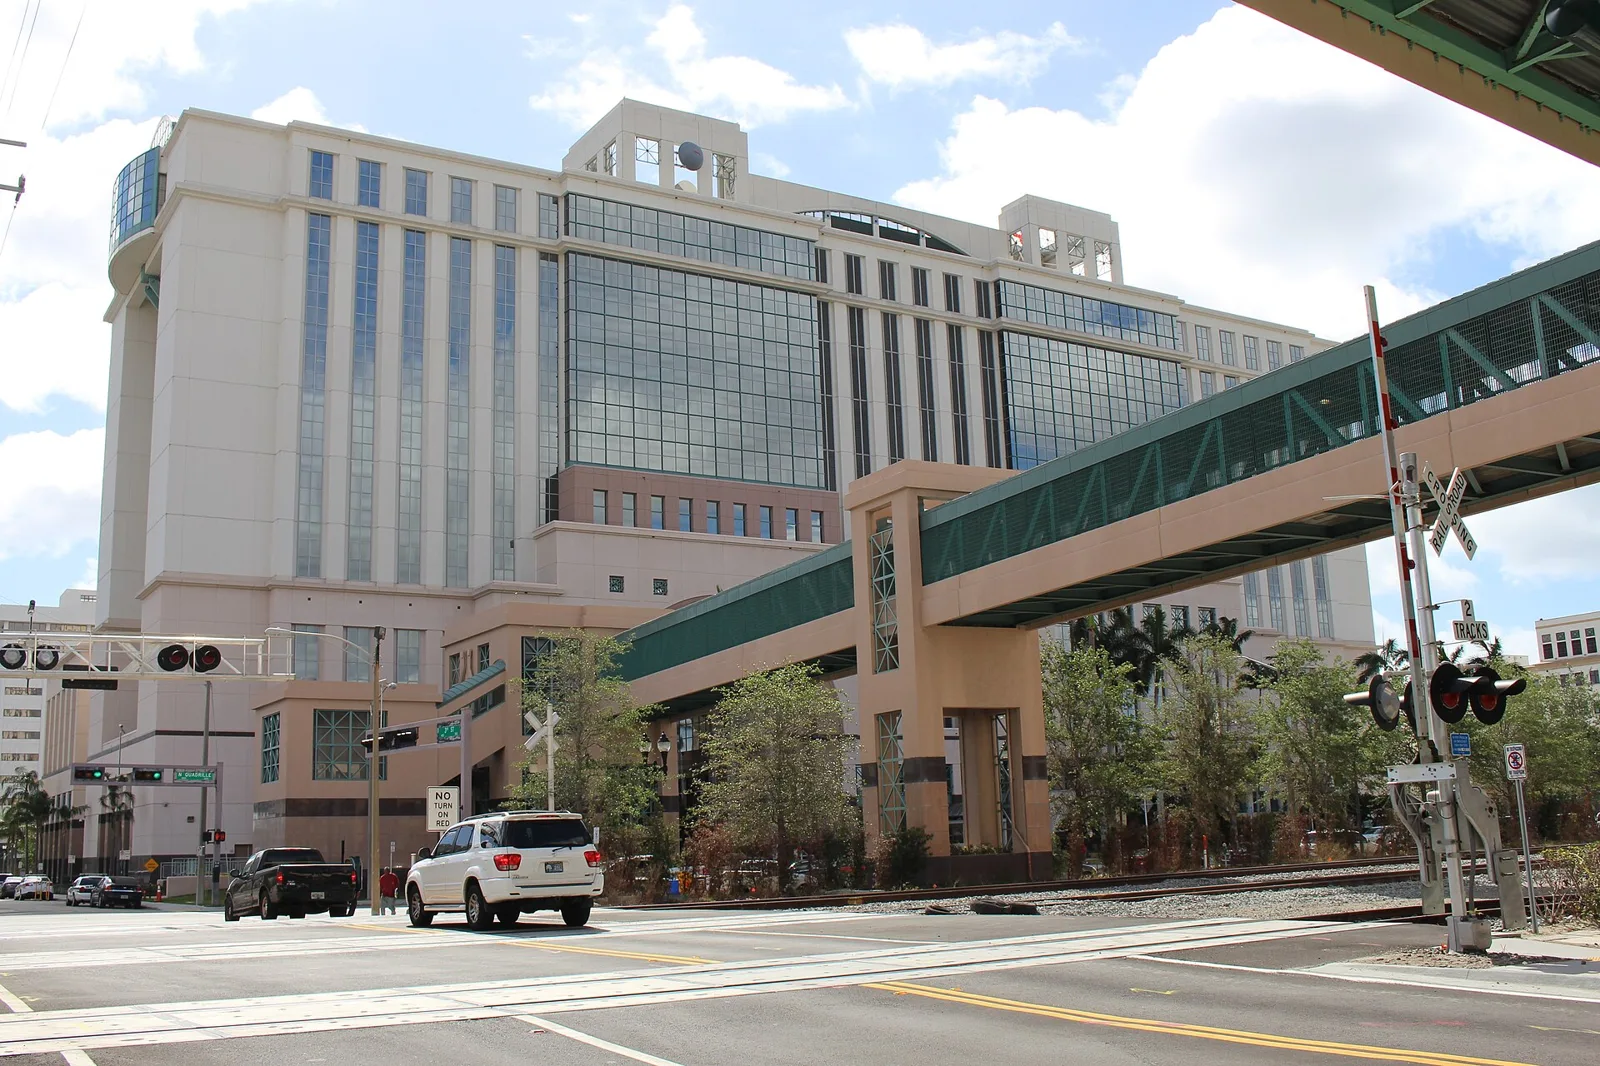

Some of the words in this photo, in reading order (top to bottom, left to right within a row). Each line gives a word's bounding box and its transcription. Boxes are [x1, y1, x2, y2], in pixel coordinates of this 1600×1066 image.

[1427, 470, 1474, 552] CROSSING
[1464, 600, 1472, 617] 2
[1454, 622, 1488, 639] TRACKS
[435, 791, 451, 801] NO
[434, 802, 453, 810] TURN
